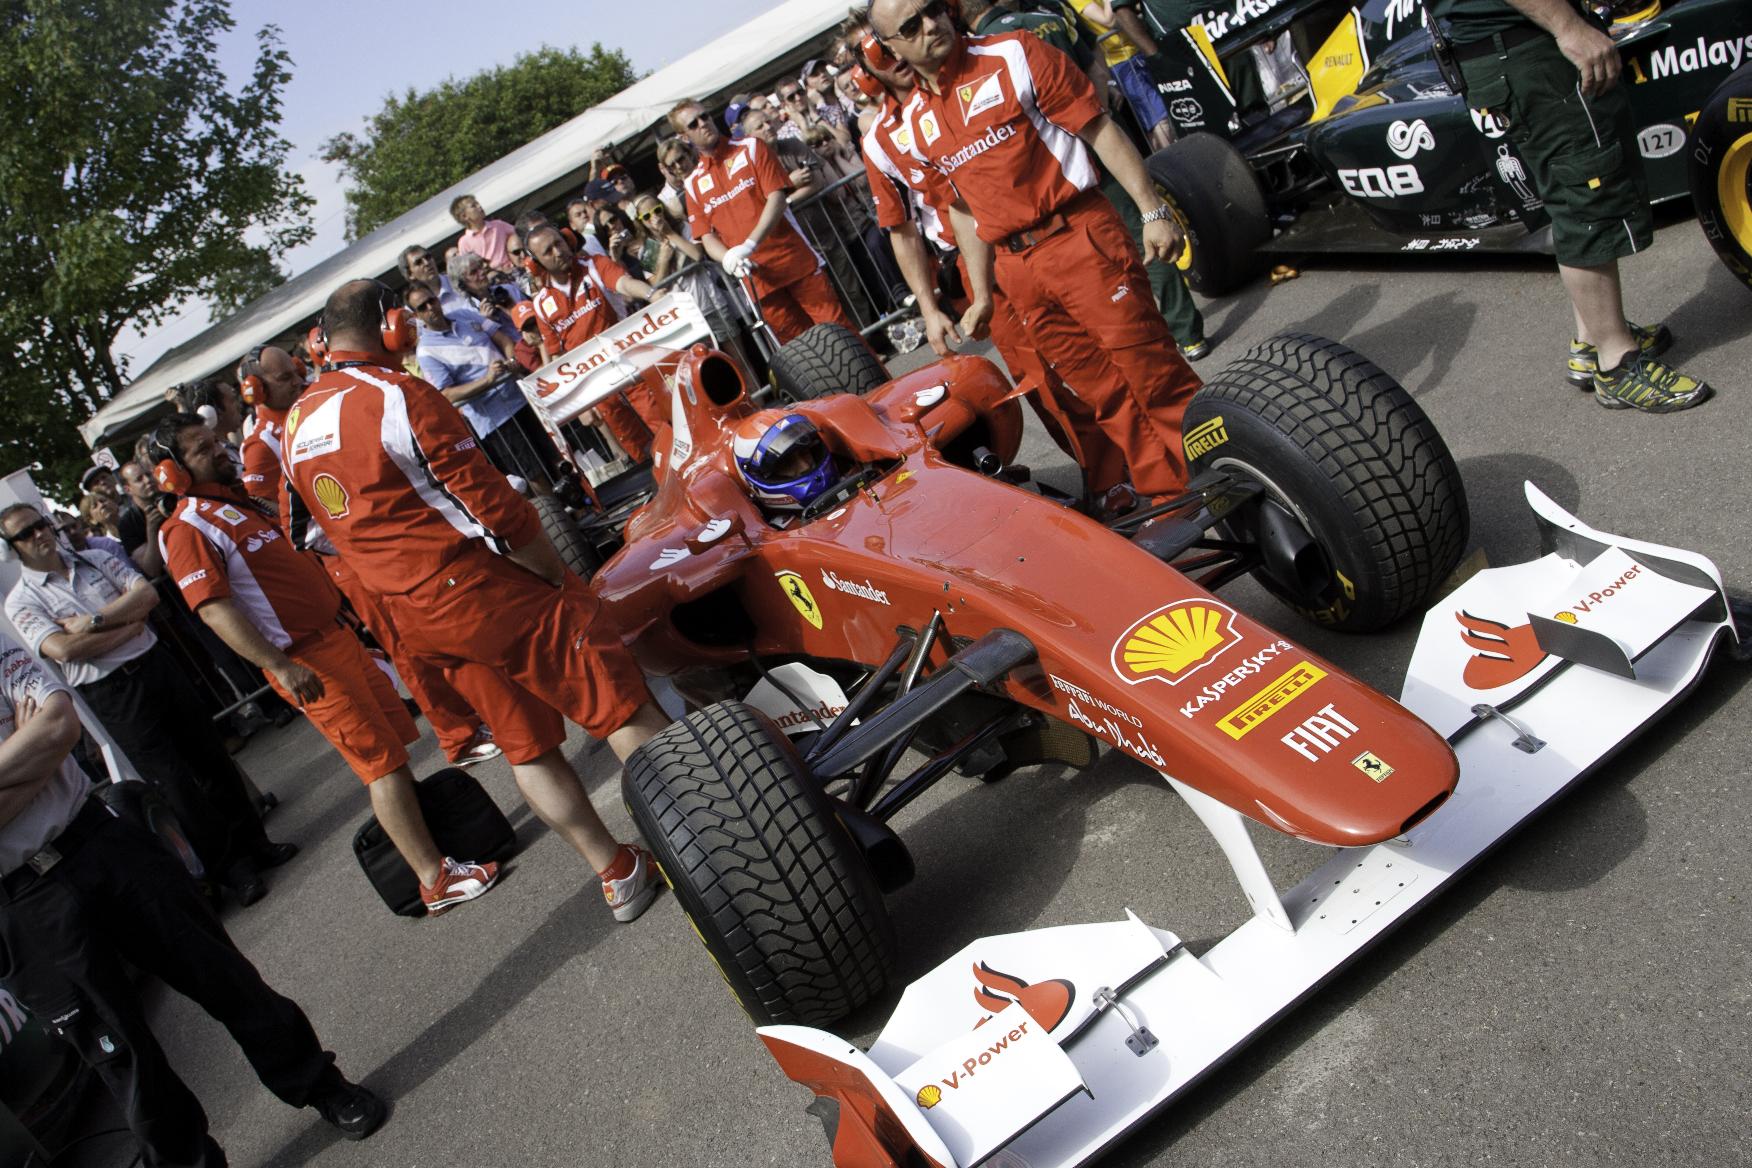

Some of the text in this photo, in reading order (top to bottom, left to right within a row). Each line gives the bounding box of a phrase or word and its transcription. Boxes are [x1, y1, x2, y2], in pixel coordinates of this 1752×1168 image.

[1324, 53, 1353, 67] RENAULT
[1158, 80, 1193, 94] NAZA
[941, 122, 1017, 172] Santander
[1642, 131, 1674, 153] 127
[1337, 164, 1425, 198] EQ8
[557, 304, 682, 384] Sannder
[1183, 415, 1230, 462] PIRELLI
[829, 571, 891, 606] Santander
[1572, 564, 1642, 613] V-Power
[1049, 673, 1143, 728] Ferrari WORLD
[1179, 643, 1282, 719] KASPERSKY
[1228, 668, 1315, 731] PIRELLI
[1068, 697, 1167, 767] Abu Dhabi
[1280, 703, 1360, 763] FIAT
[941, 1021, 1028, 1090] V-Power
